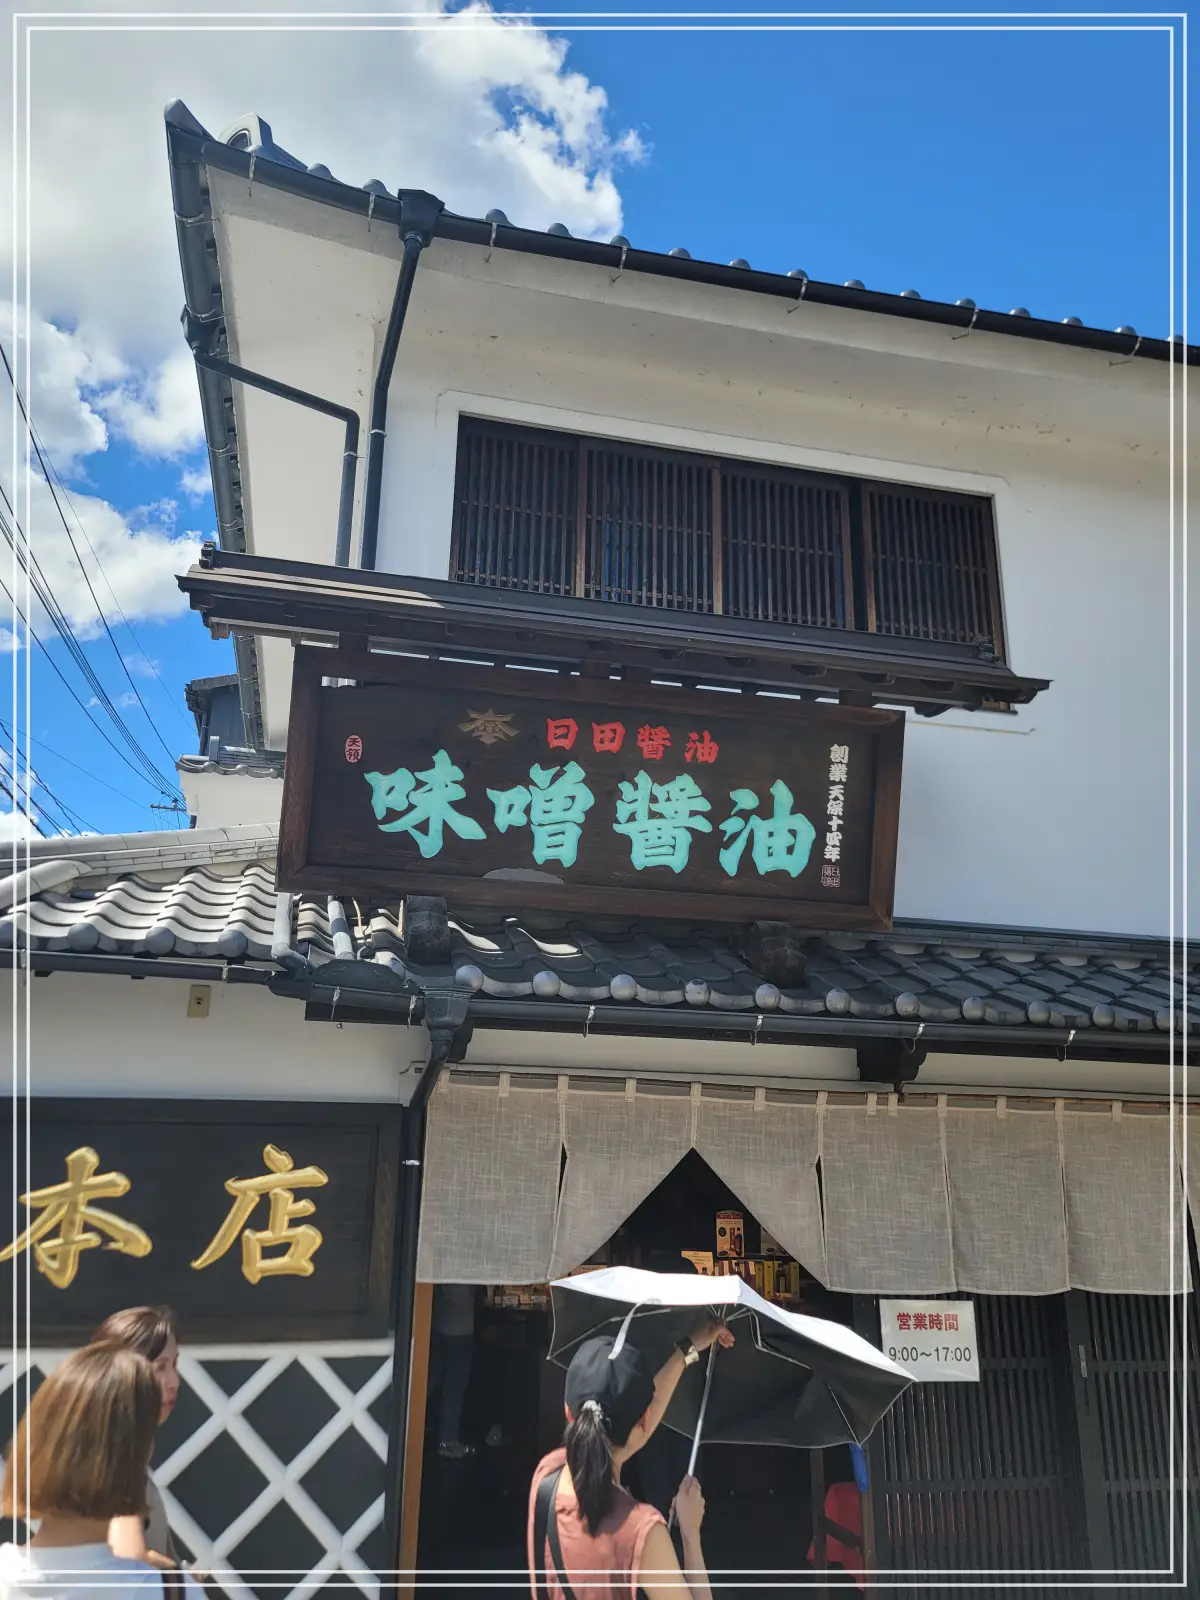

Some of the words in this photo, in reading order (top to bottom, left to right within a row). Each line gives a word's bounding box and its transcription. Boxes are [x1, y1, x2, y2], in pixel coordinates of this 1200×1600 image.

[346, 736, 362, 762] 天領
[0, 1143, 329, 1289] 本店
[896, 1312, 959, 1331] 営業時間
